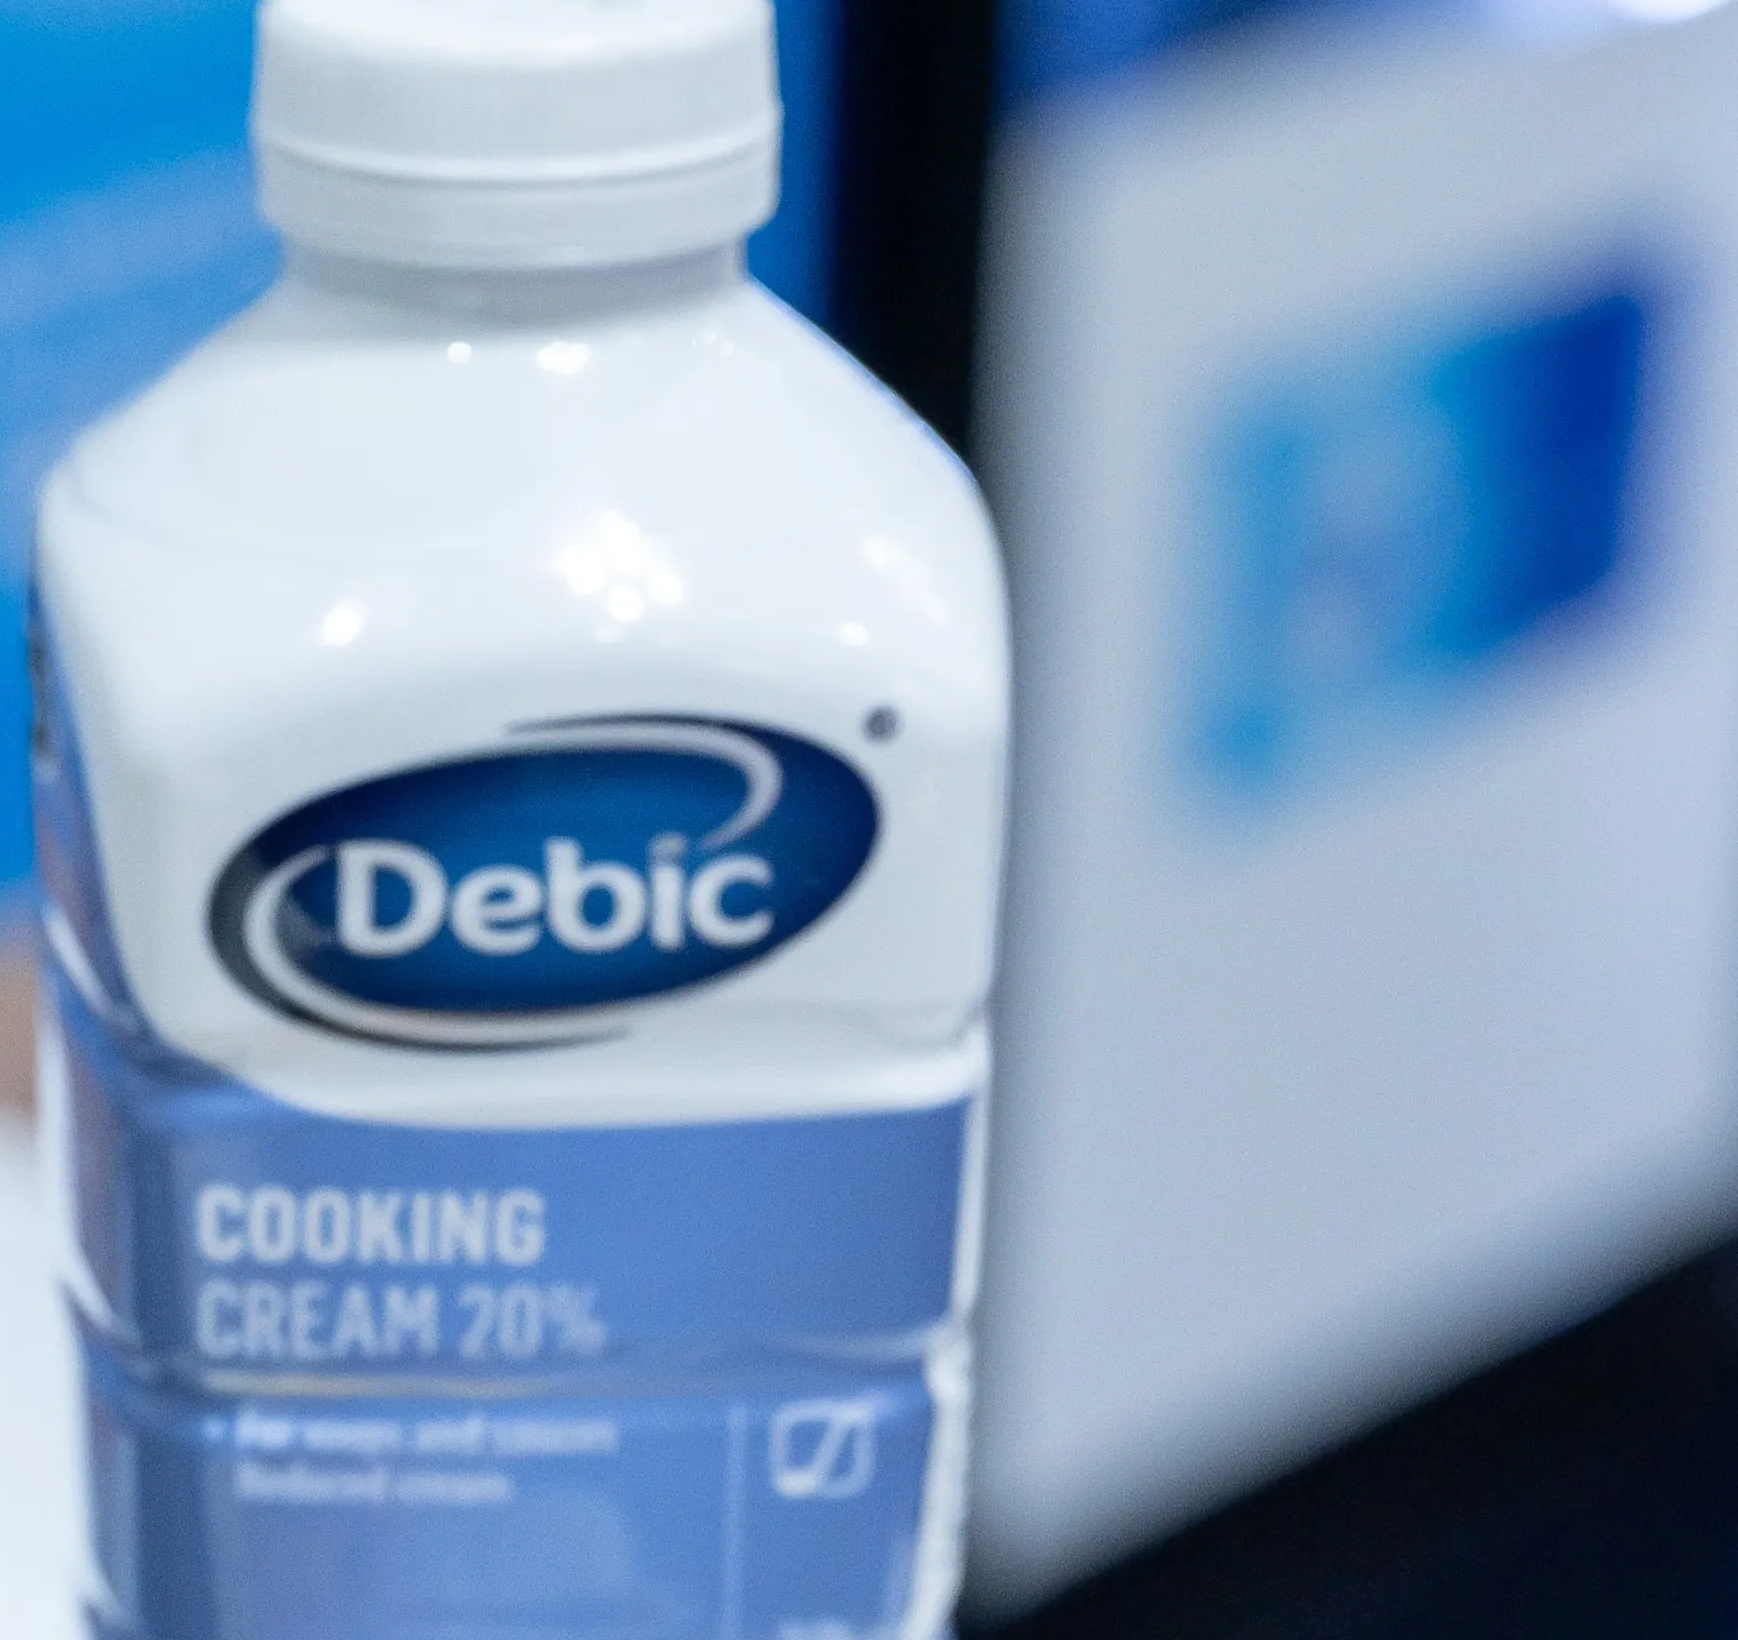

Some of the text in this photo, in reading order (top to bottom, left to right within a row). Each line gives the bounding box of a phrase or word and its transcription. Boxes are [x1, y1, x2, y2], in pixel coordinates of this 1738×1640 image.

[335, 836, 774, 958] Debic
[197, 1184, 545, 1265] COOKING
[197, 1282, 608, 1359] CREAM 20%
